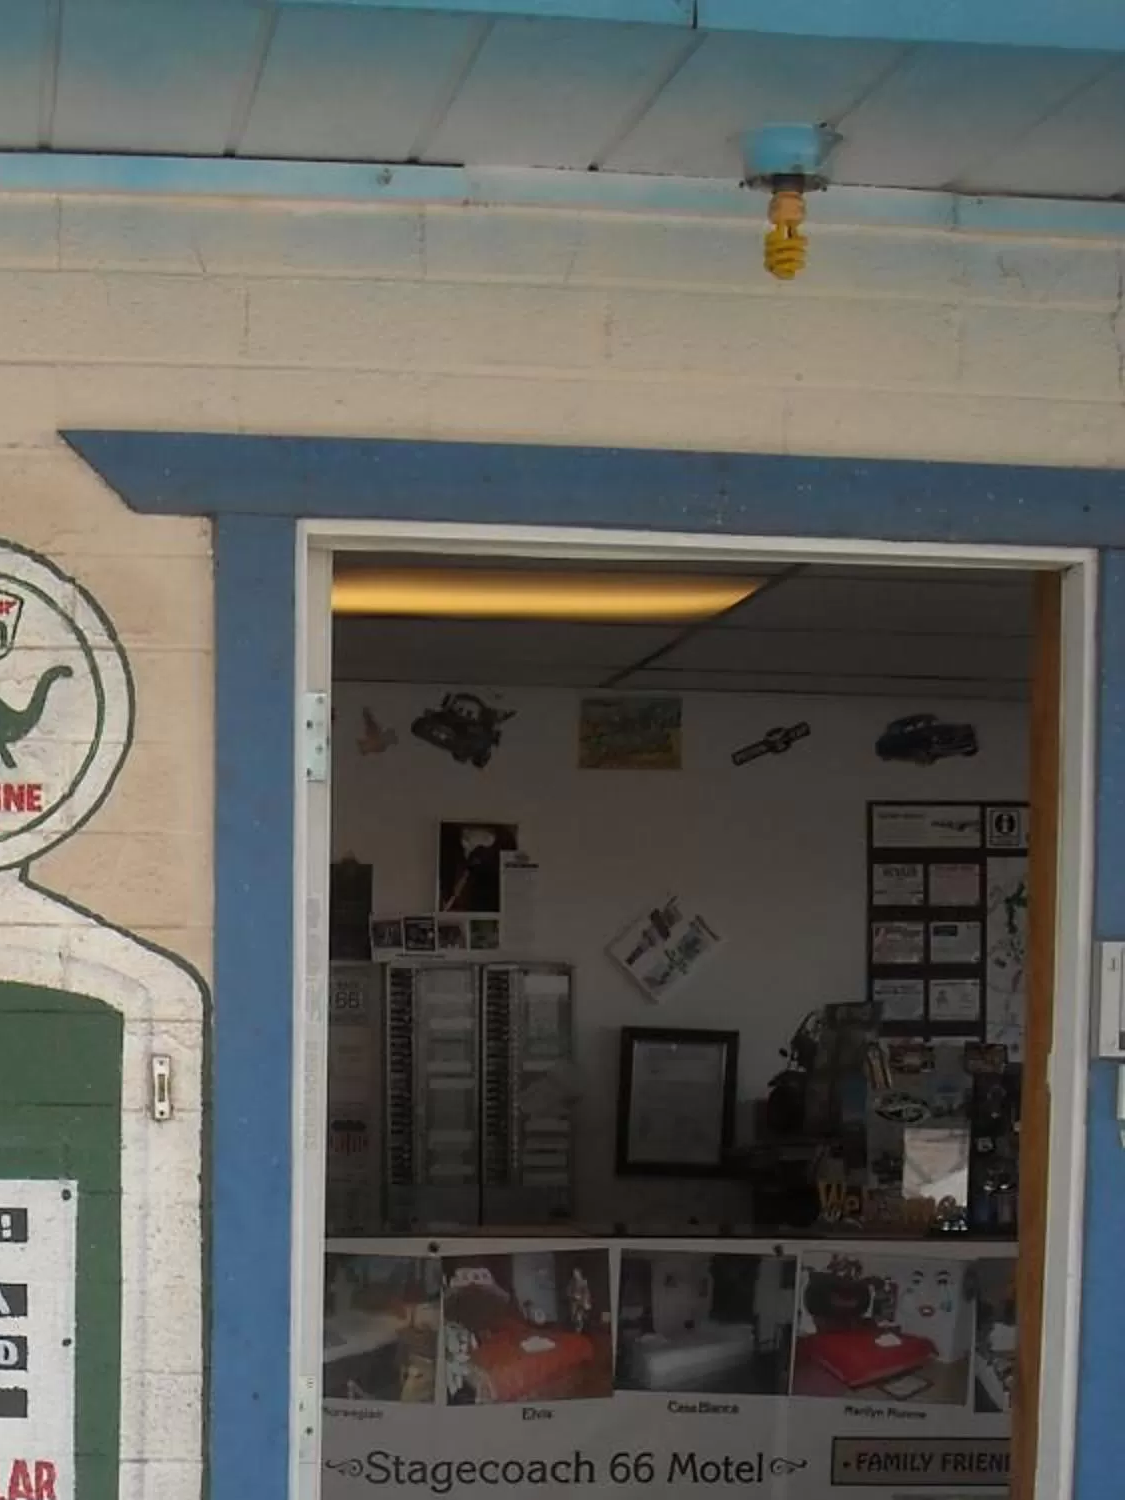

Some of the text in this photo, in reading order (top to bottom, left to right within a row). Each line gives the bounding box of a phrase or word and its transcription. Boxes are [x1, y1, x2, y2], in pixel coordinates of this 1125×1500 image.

[365, 1450, 764, 1493] Stagecoach 66 Motel
[856, 1452, 935, 1473] FAMILY
